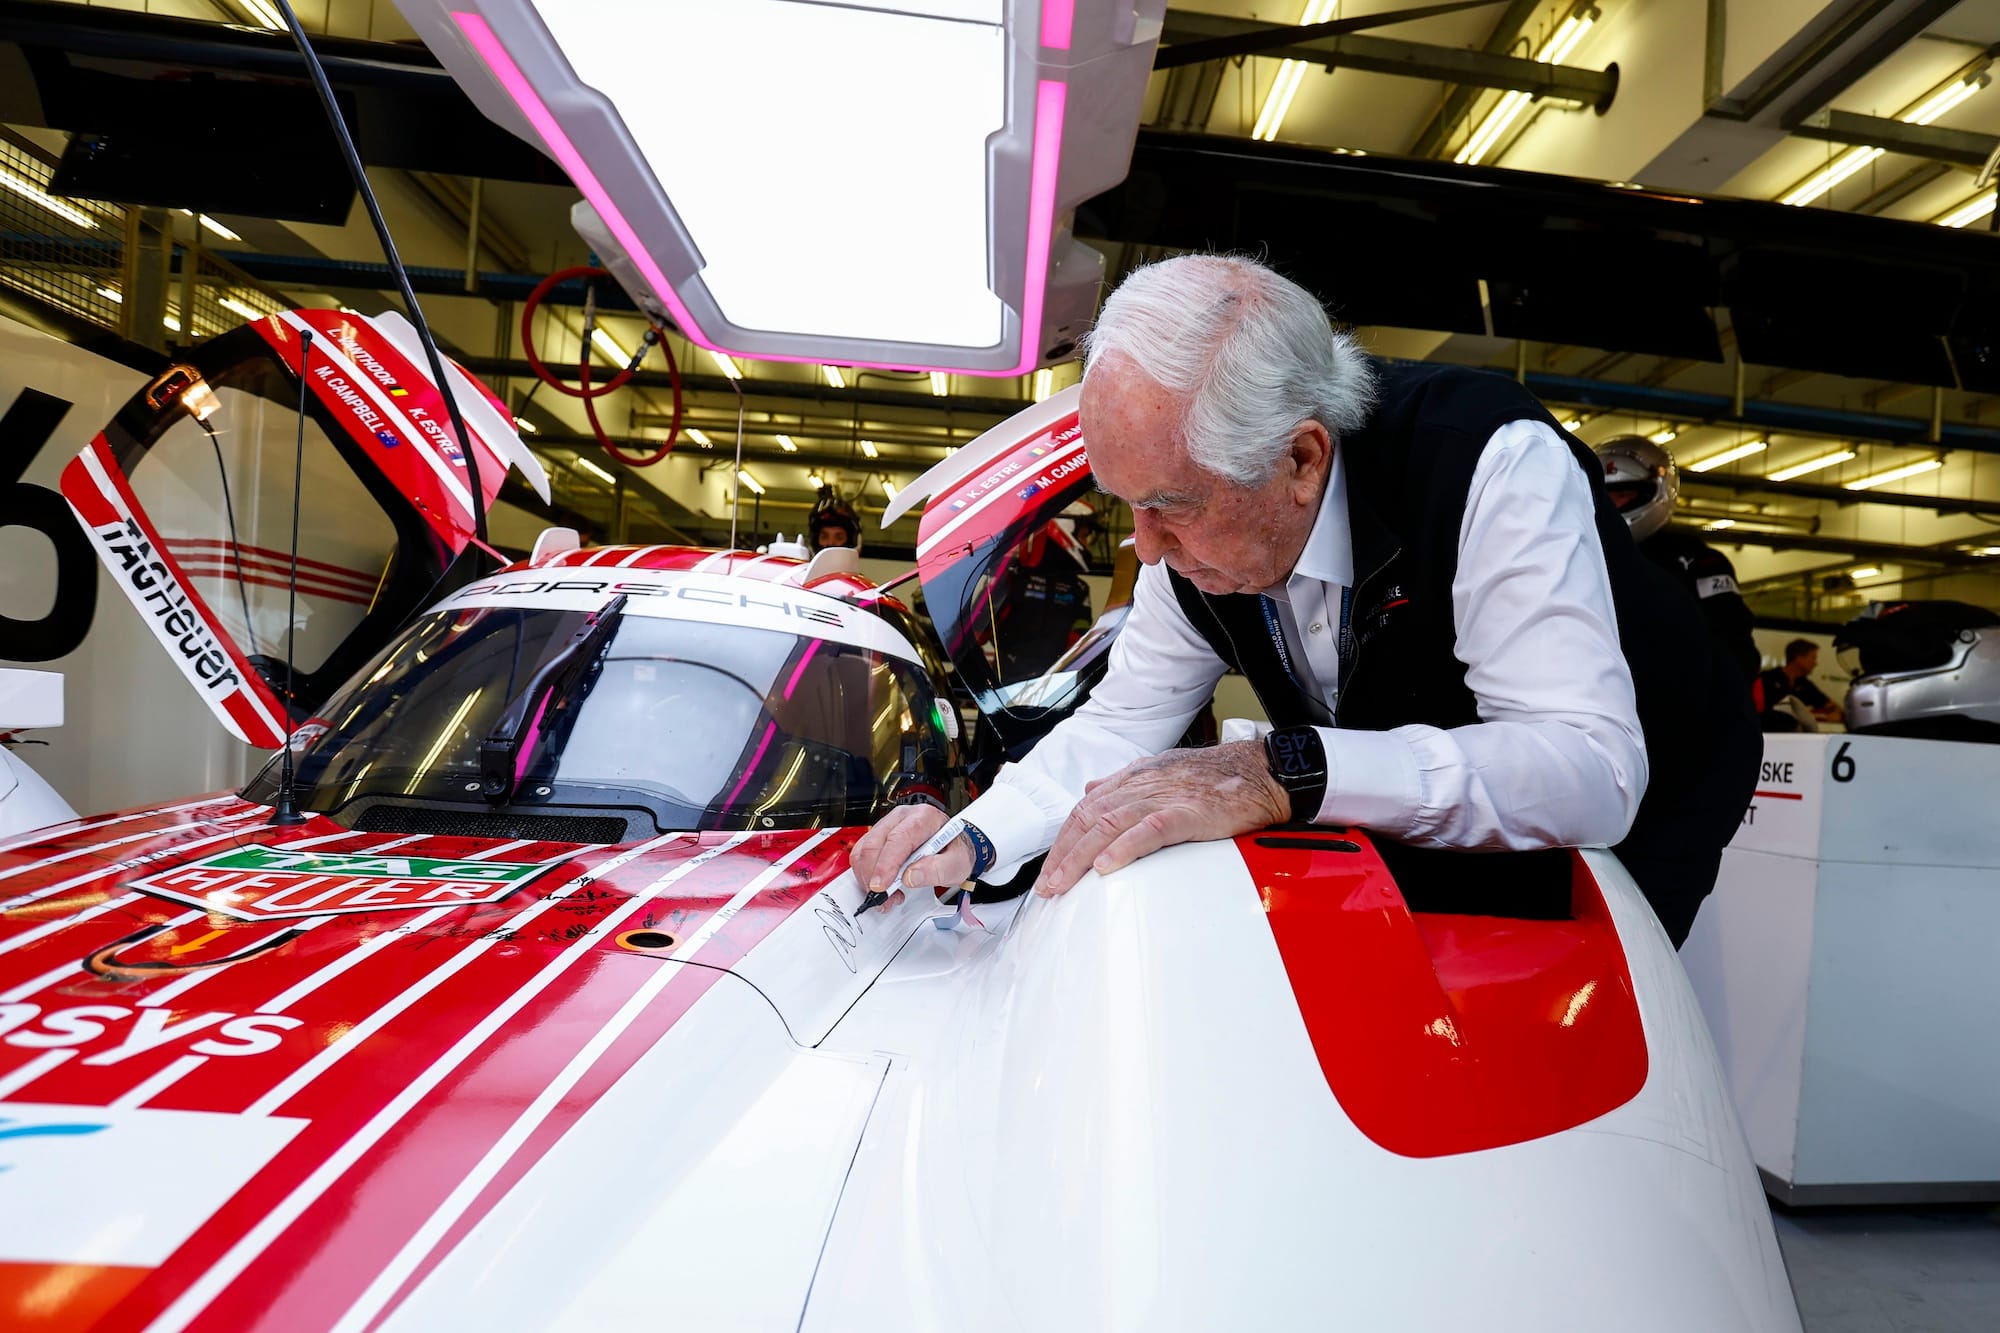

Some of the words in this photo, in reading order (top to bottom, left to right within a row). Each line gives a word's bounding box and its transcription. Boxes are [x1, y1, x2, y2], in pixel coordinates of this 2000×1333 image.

[339, 335, 397, 386] VANTHOOR
[314, 366, 330, 381] M.
[328, 378, 385, 434] CAMPBELL
[408, 407, 426, 420] K.
[420, 420, 459, 454] ESTRE
[966, 489, 984, 499] K.
[982, 461, 1019, 489] ESTRE
[1035, 475, 1056, 489] M.
[452, 581, 845, 628] PORSCHE
[1831, 741, 1855, 783] 6
[258, 849, 522, 880] TAG
[165, 870, 494, 912] HEUER
